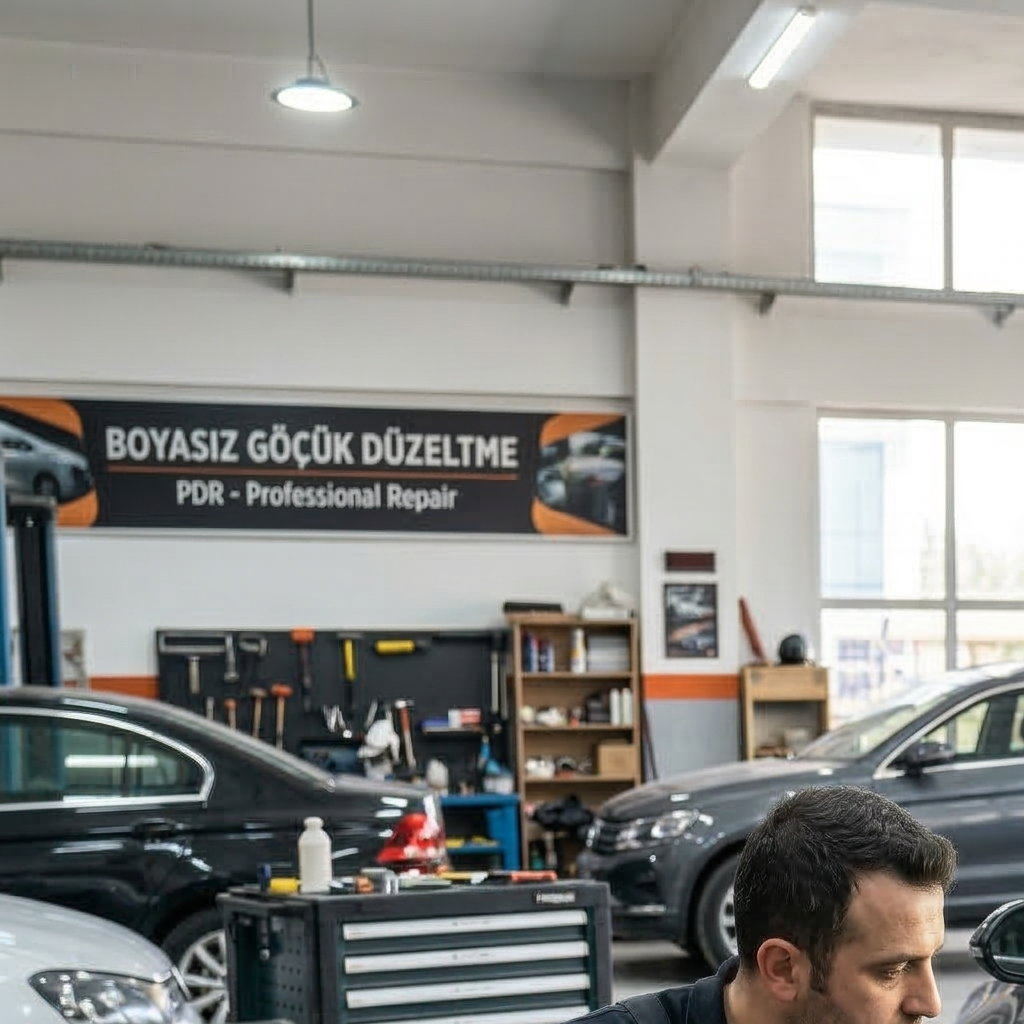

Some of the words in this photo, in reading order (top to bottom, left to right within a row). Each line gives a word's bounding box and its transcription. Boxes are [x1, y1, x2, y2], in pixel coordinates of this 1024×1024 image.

[105, 426, 240, 463] BOYASIZ
[246, 423, 355, 470] GÖÇÜK
[361, 426, 519, 468] DÜZELTME
[175, 479, 225, 506] PDR
[245, 480, 381, 508] Professional
[386, 483, 458, 513] Repair
